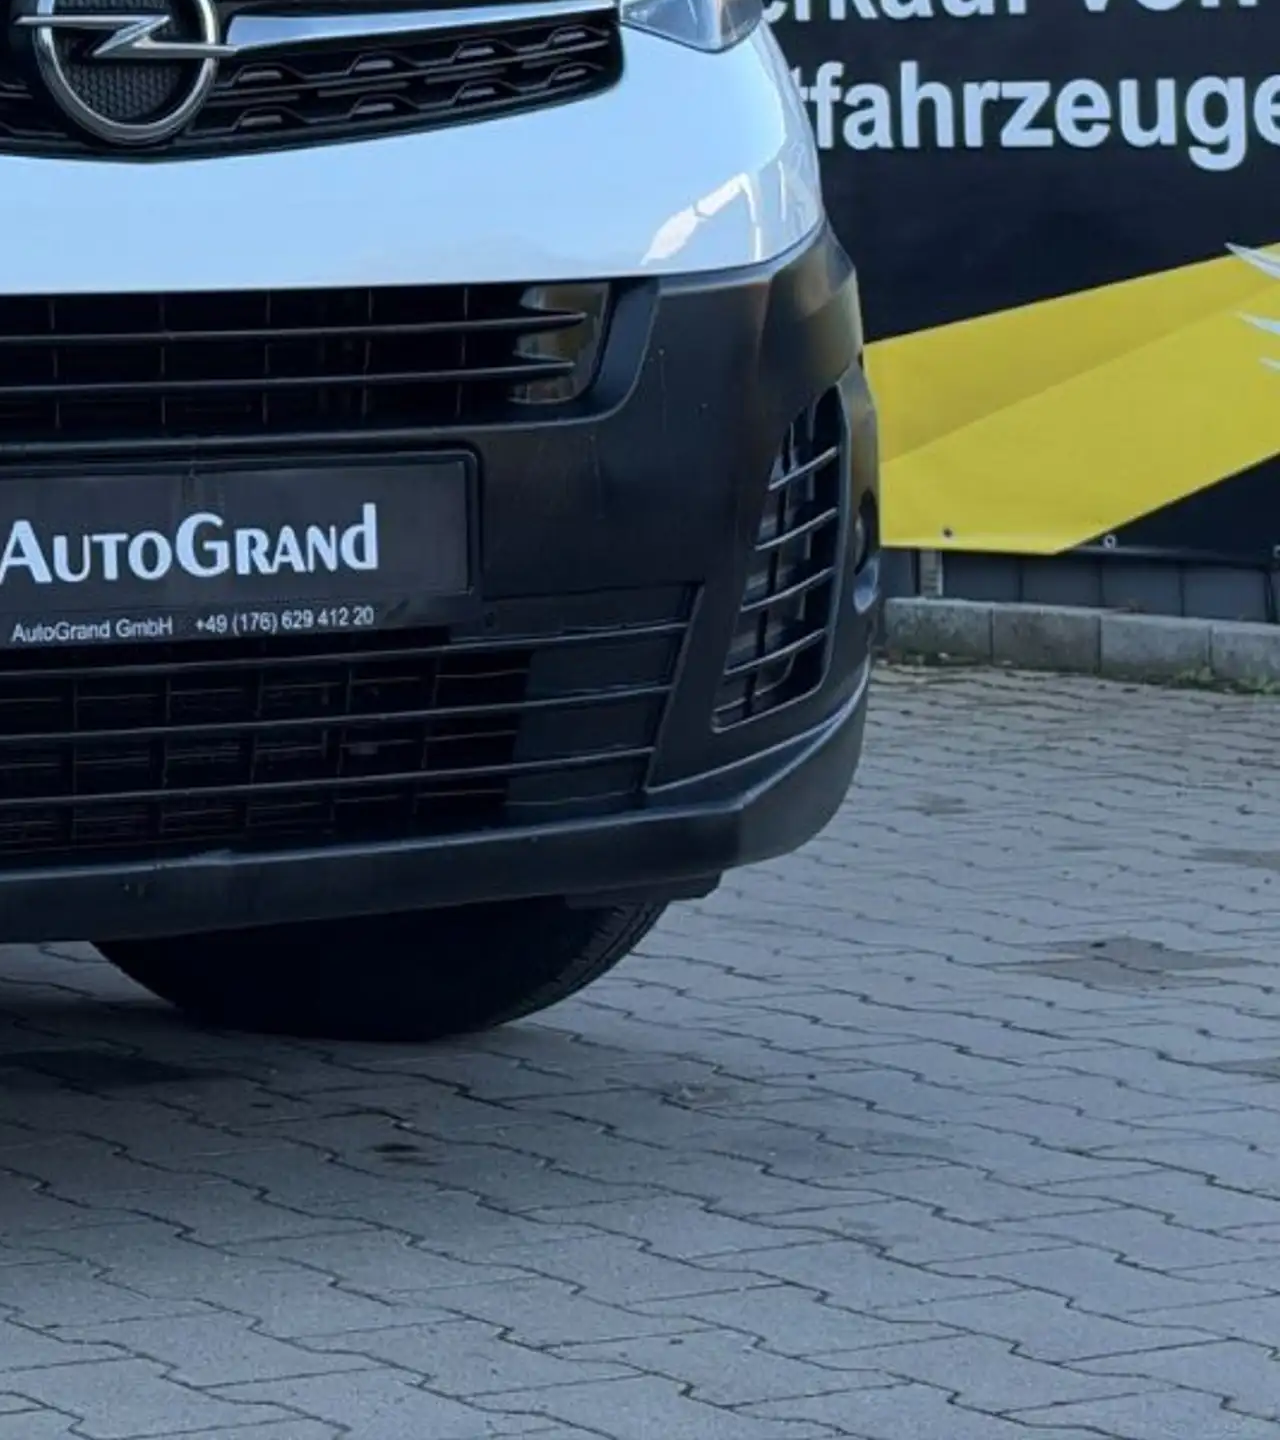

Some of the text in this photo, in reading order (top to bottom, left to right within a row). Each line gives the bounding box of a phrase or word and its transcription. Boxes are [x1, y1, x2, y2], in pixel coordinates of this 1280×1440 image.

[11, 606, 375, 642] AutoGrand GmbH +49 (176) 629 412 20
